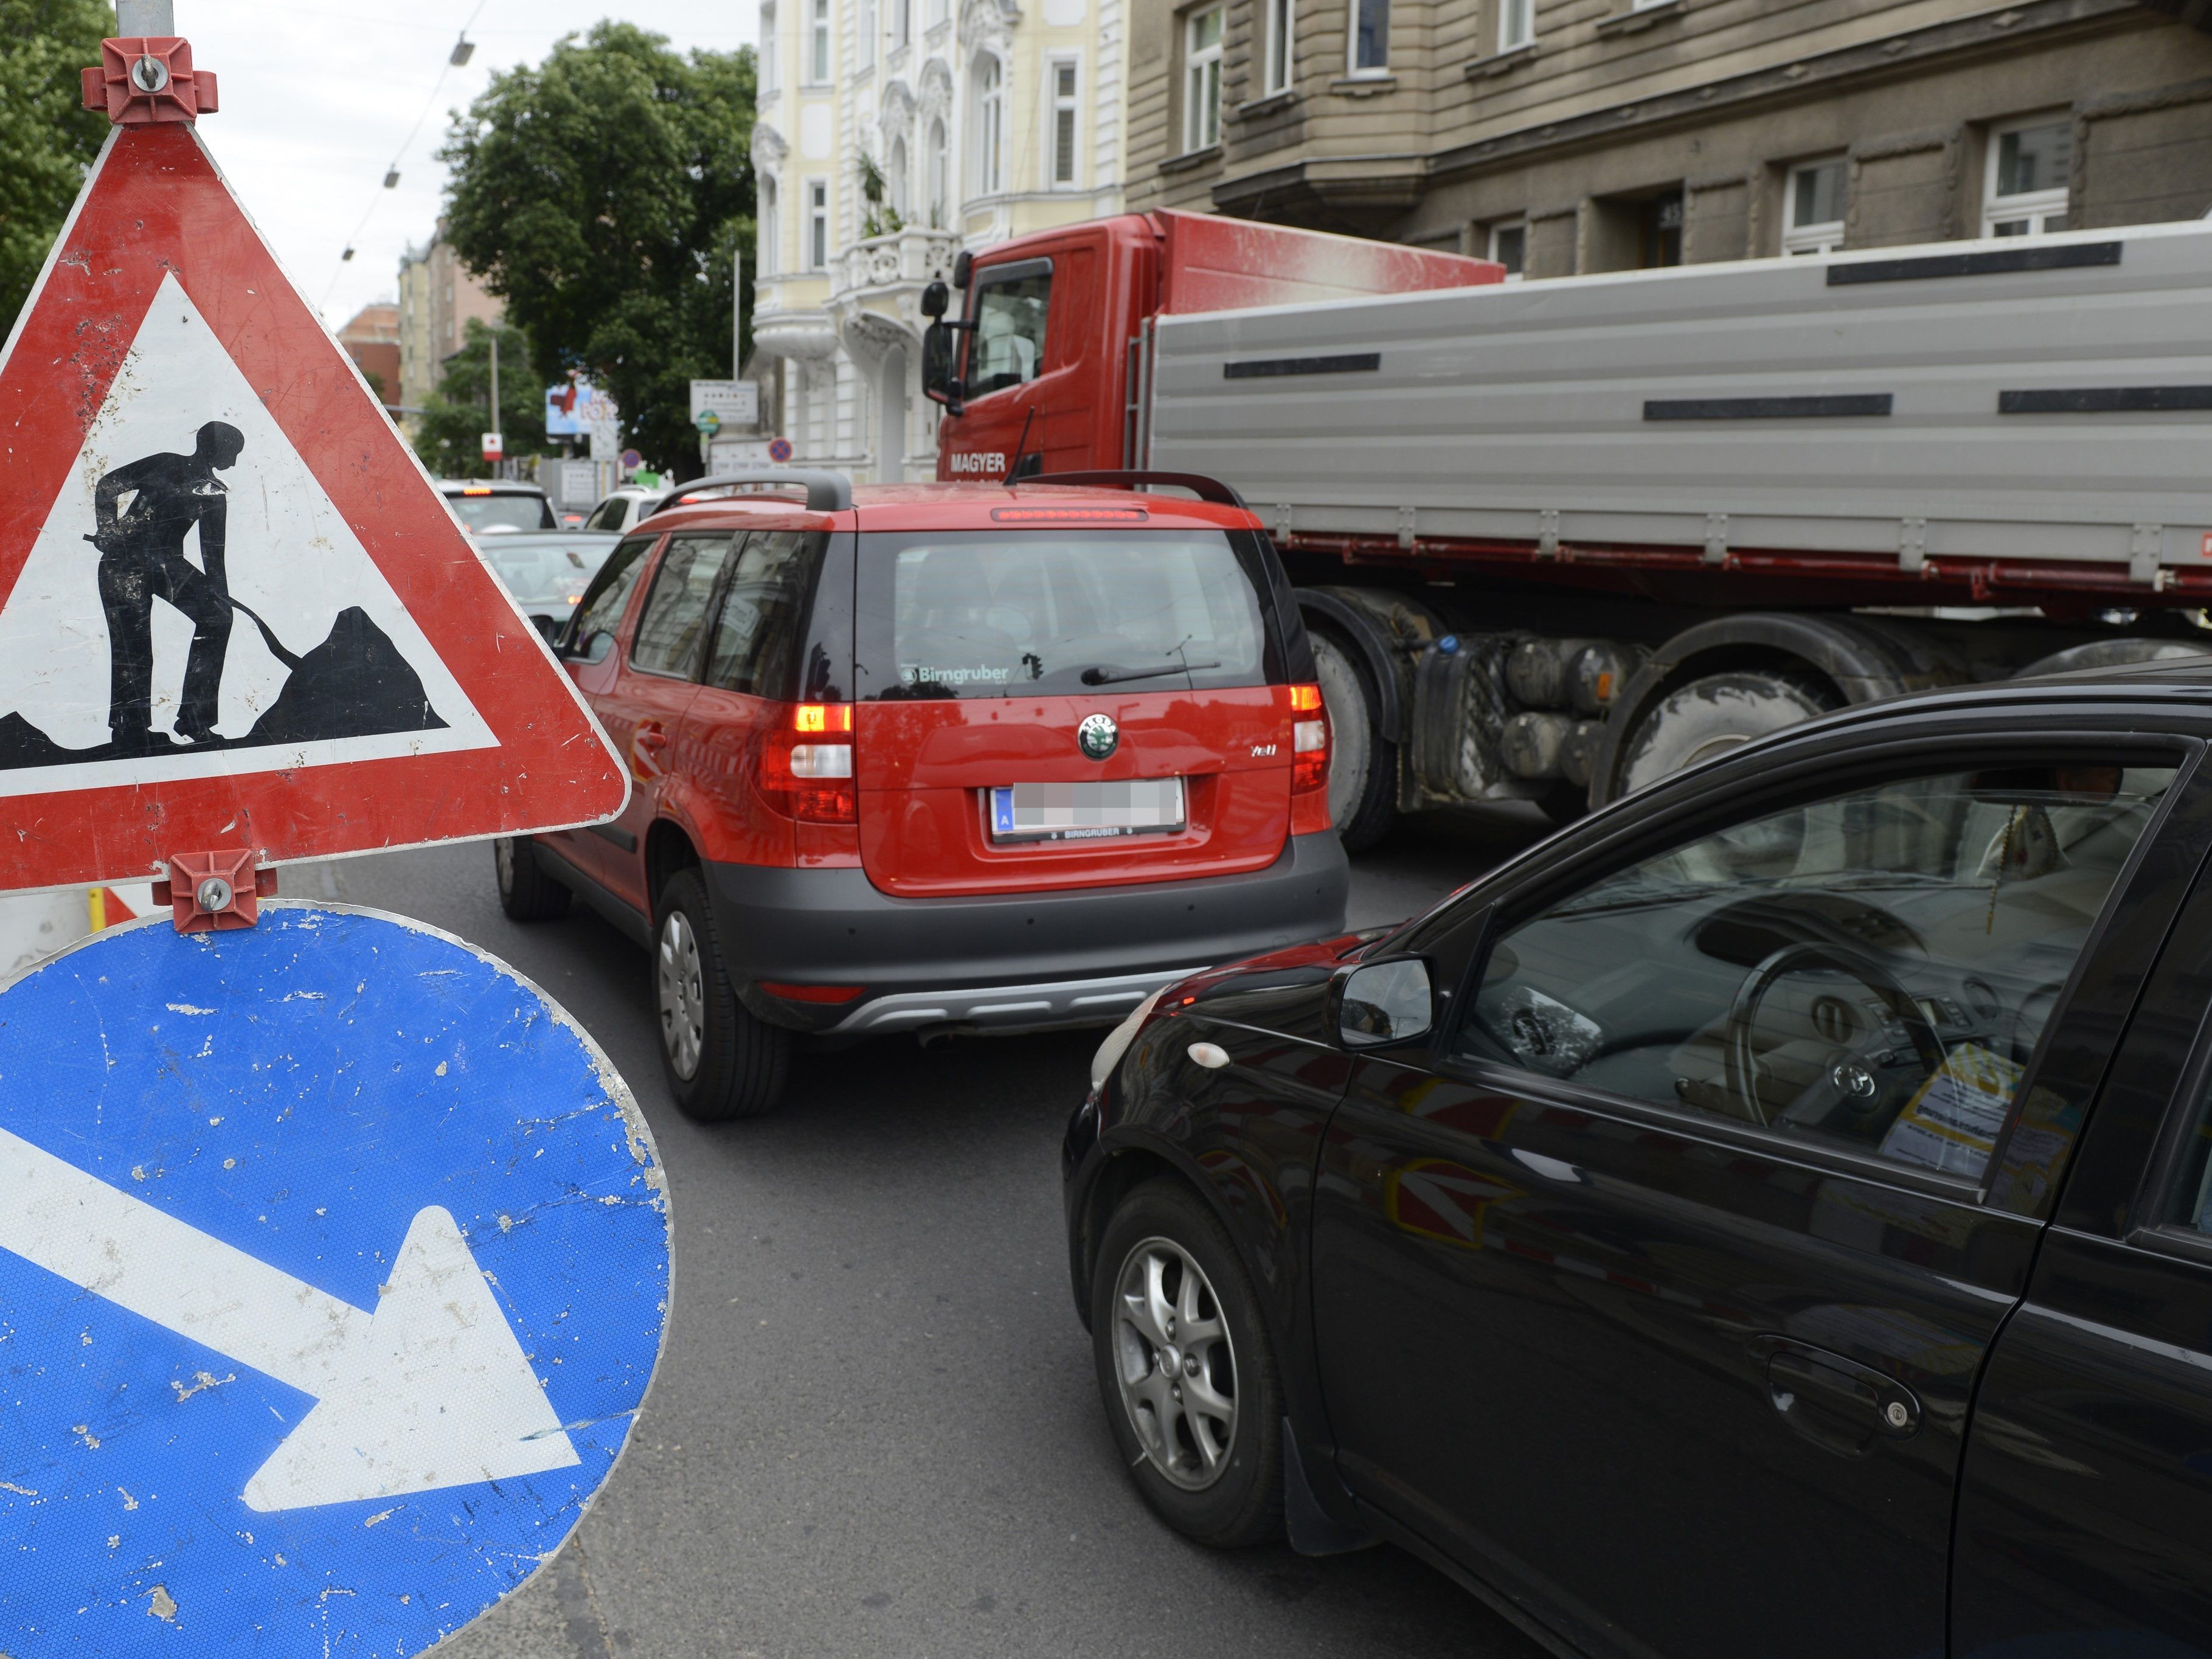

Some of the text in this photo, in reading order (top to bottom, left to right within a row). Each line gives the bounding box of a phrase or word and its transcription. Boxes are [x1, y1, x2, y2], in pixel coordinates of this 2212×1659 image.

[951, 452, 1005, 473] MAGYER
[919, 664, 1009, 685] Birngruber
[1000, 814, 1010, 825] A
[1064, 827, 1120, 839] BIRNGRUBER
